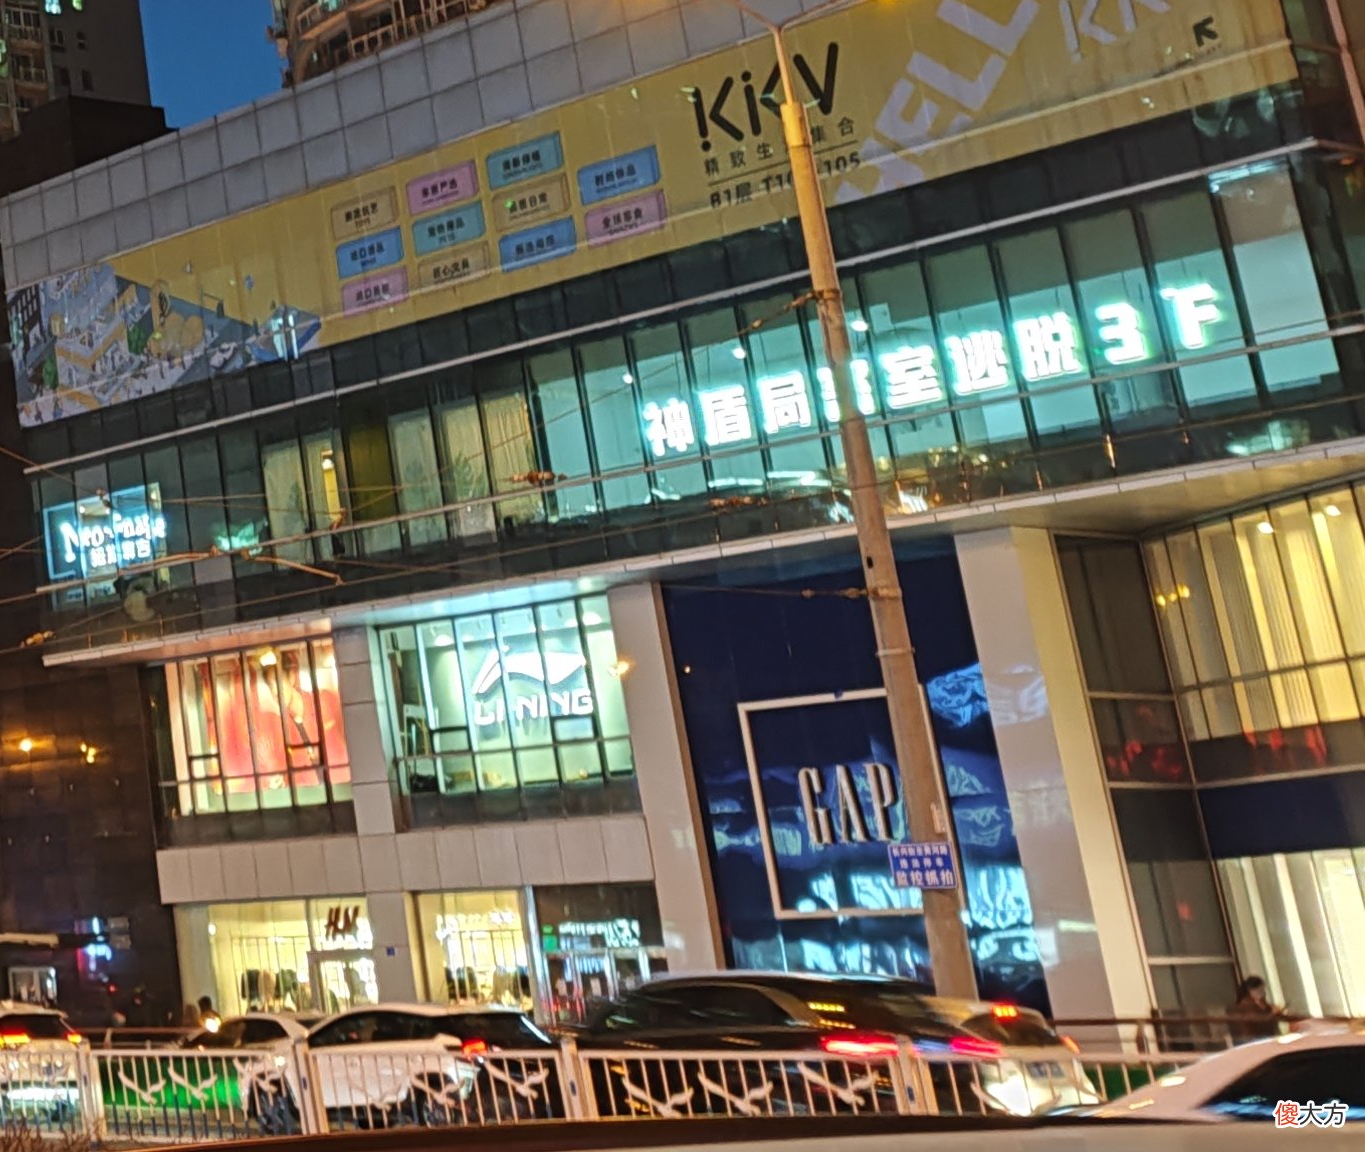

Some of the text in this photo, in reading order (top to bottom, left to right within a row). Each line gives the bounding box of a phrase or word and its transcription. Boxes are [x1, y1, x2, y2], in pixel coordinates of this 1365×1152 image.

[703, 116, 855, 177] 精致生集合
[798, 762, 897, 846] GAP
